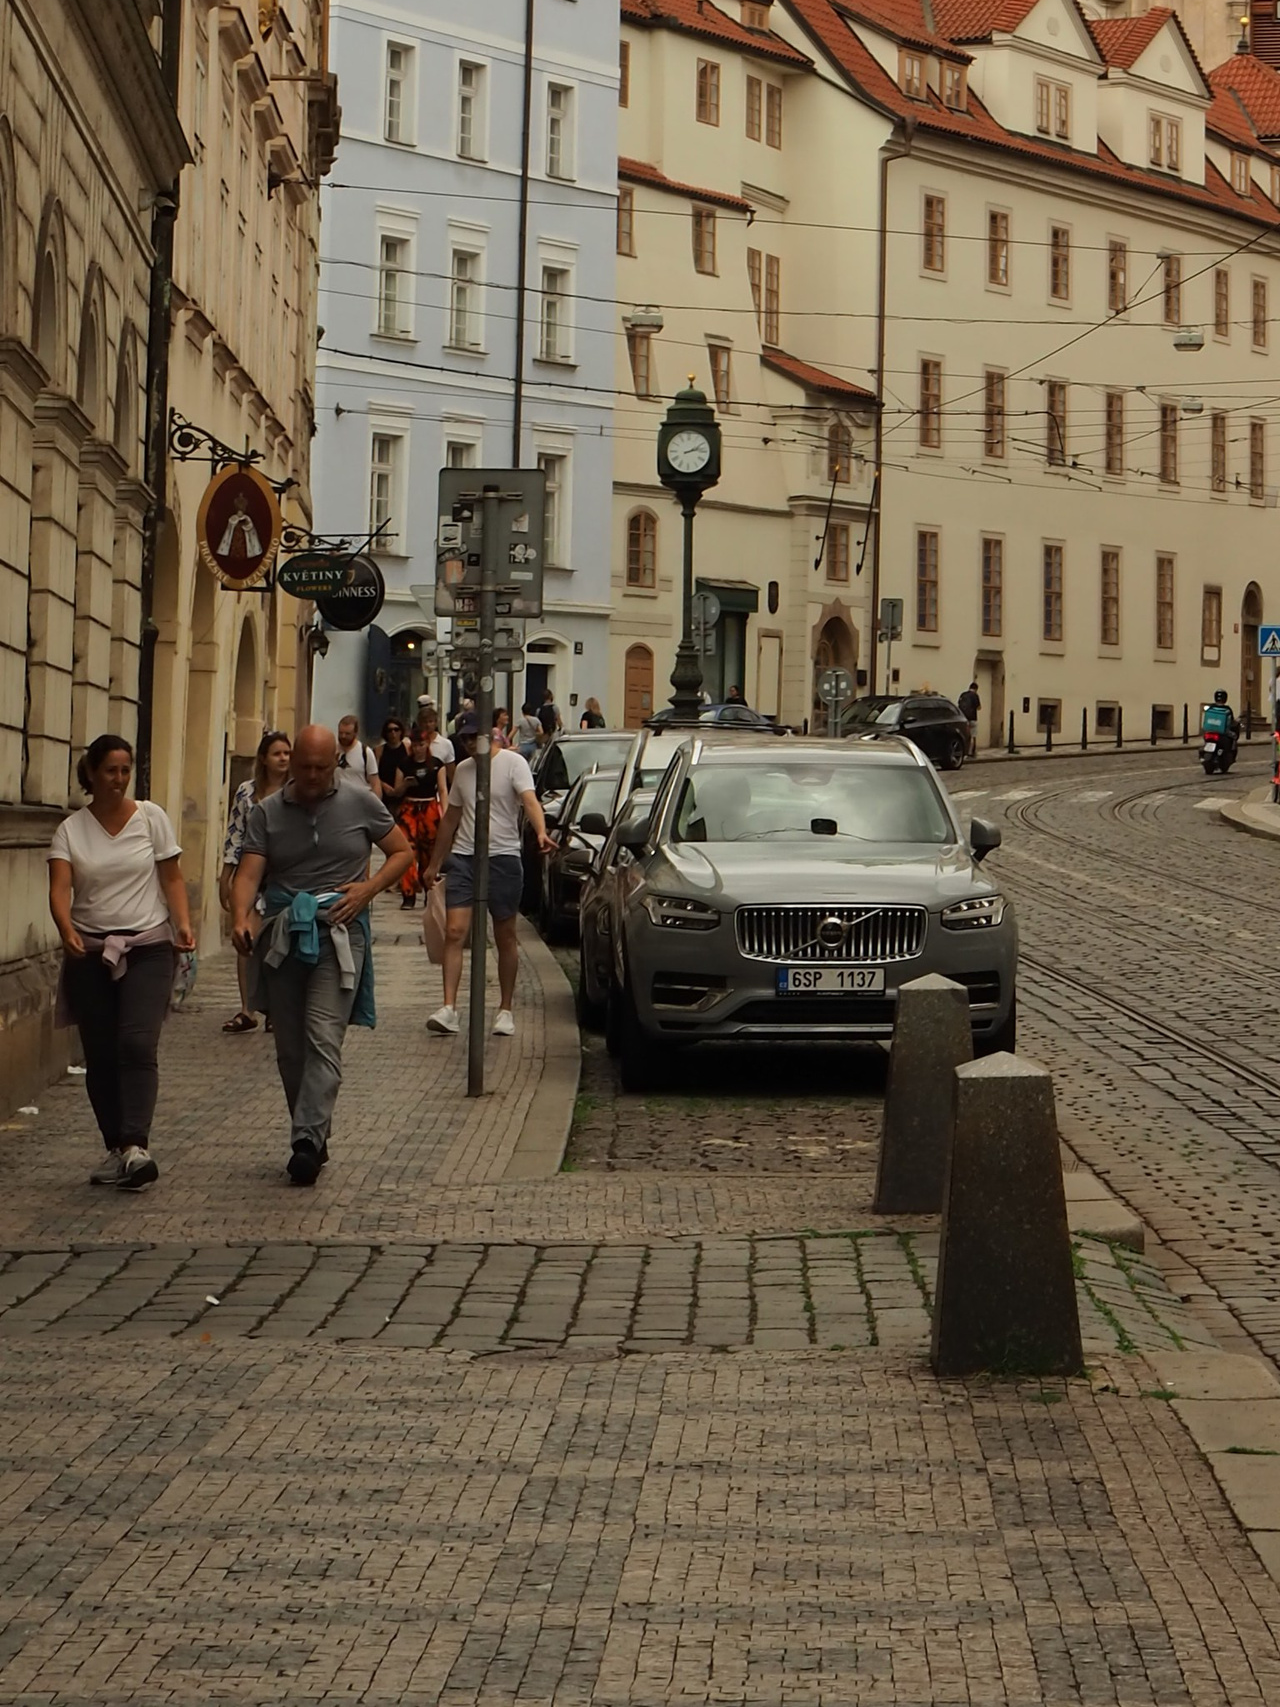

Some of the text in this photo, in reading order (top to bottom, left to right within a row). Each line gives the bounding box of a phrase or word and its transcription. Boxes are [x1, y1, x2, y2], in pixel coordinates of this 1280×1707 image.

[332, 585, 376, 598] INNESS
[792, 971, 823, 988] 6SP
[837, 971, 876, 988] 1137
